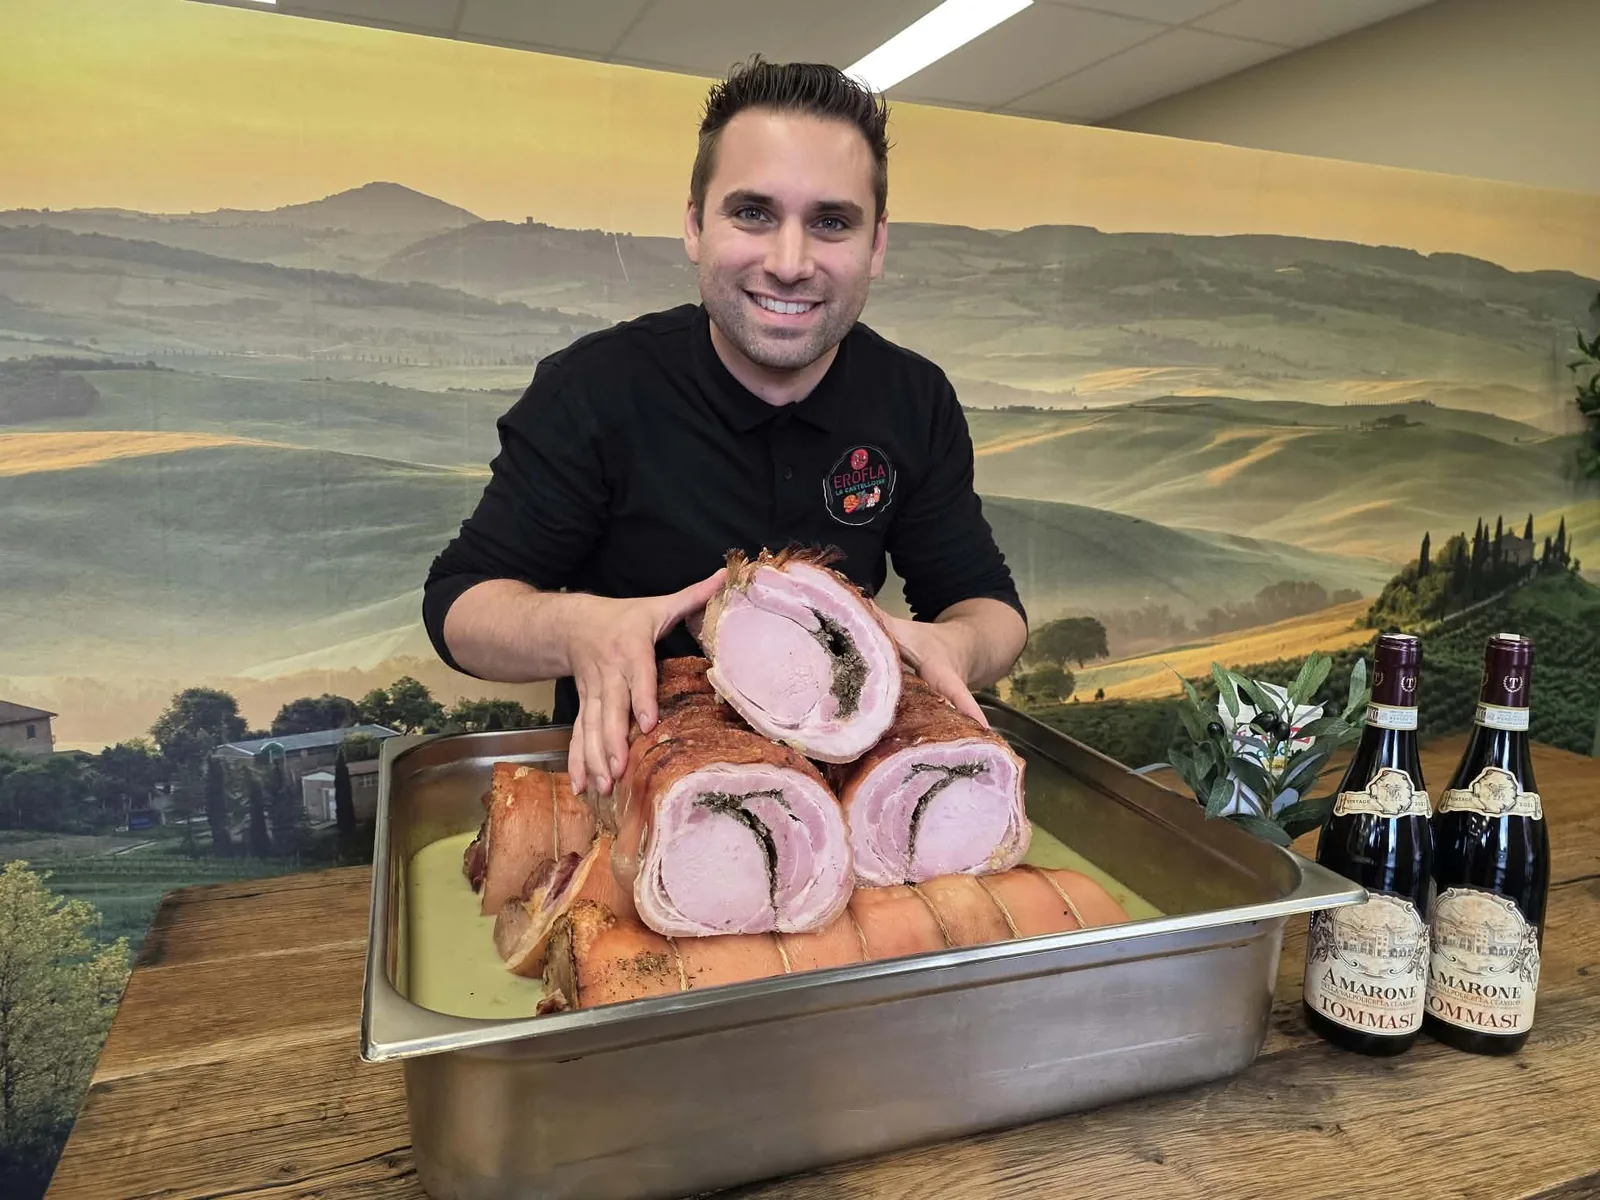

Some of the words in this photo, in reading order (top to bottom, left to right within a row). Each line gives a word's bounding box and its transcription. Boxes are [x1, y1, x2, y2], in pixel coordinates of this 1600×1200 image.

[834, 464, 886, 489] EROFLA
[1509, 677, 1519, 689] T
[1322, 967, 1418, 1000] AMARONE
[1319, 994, 1417, 1029] TOMMASI
[1425, 991, 1522, 1029] OMMASI
